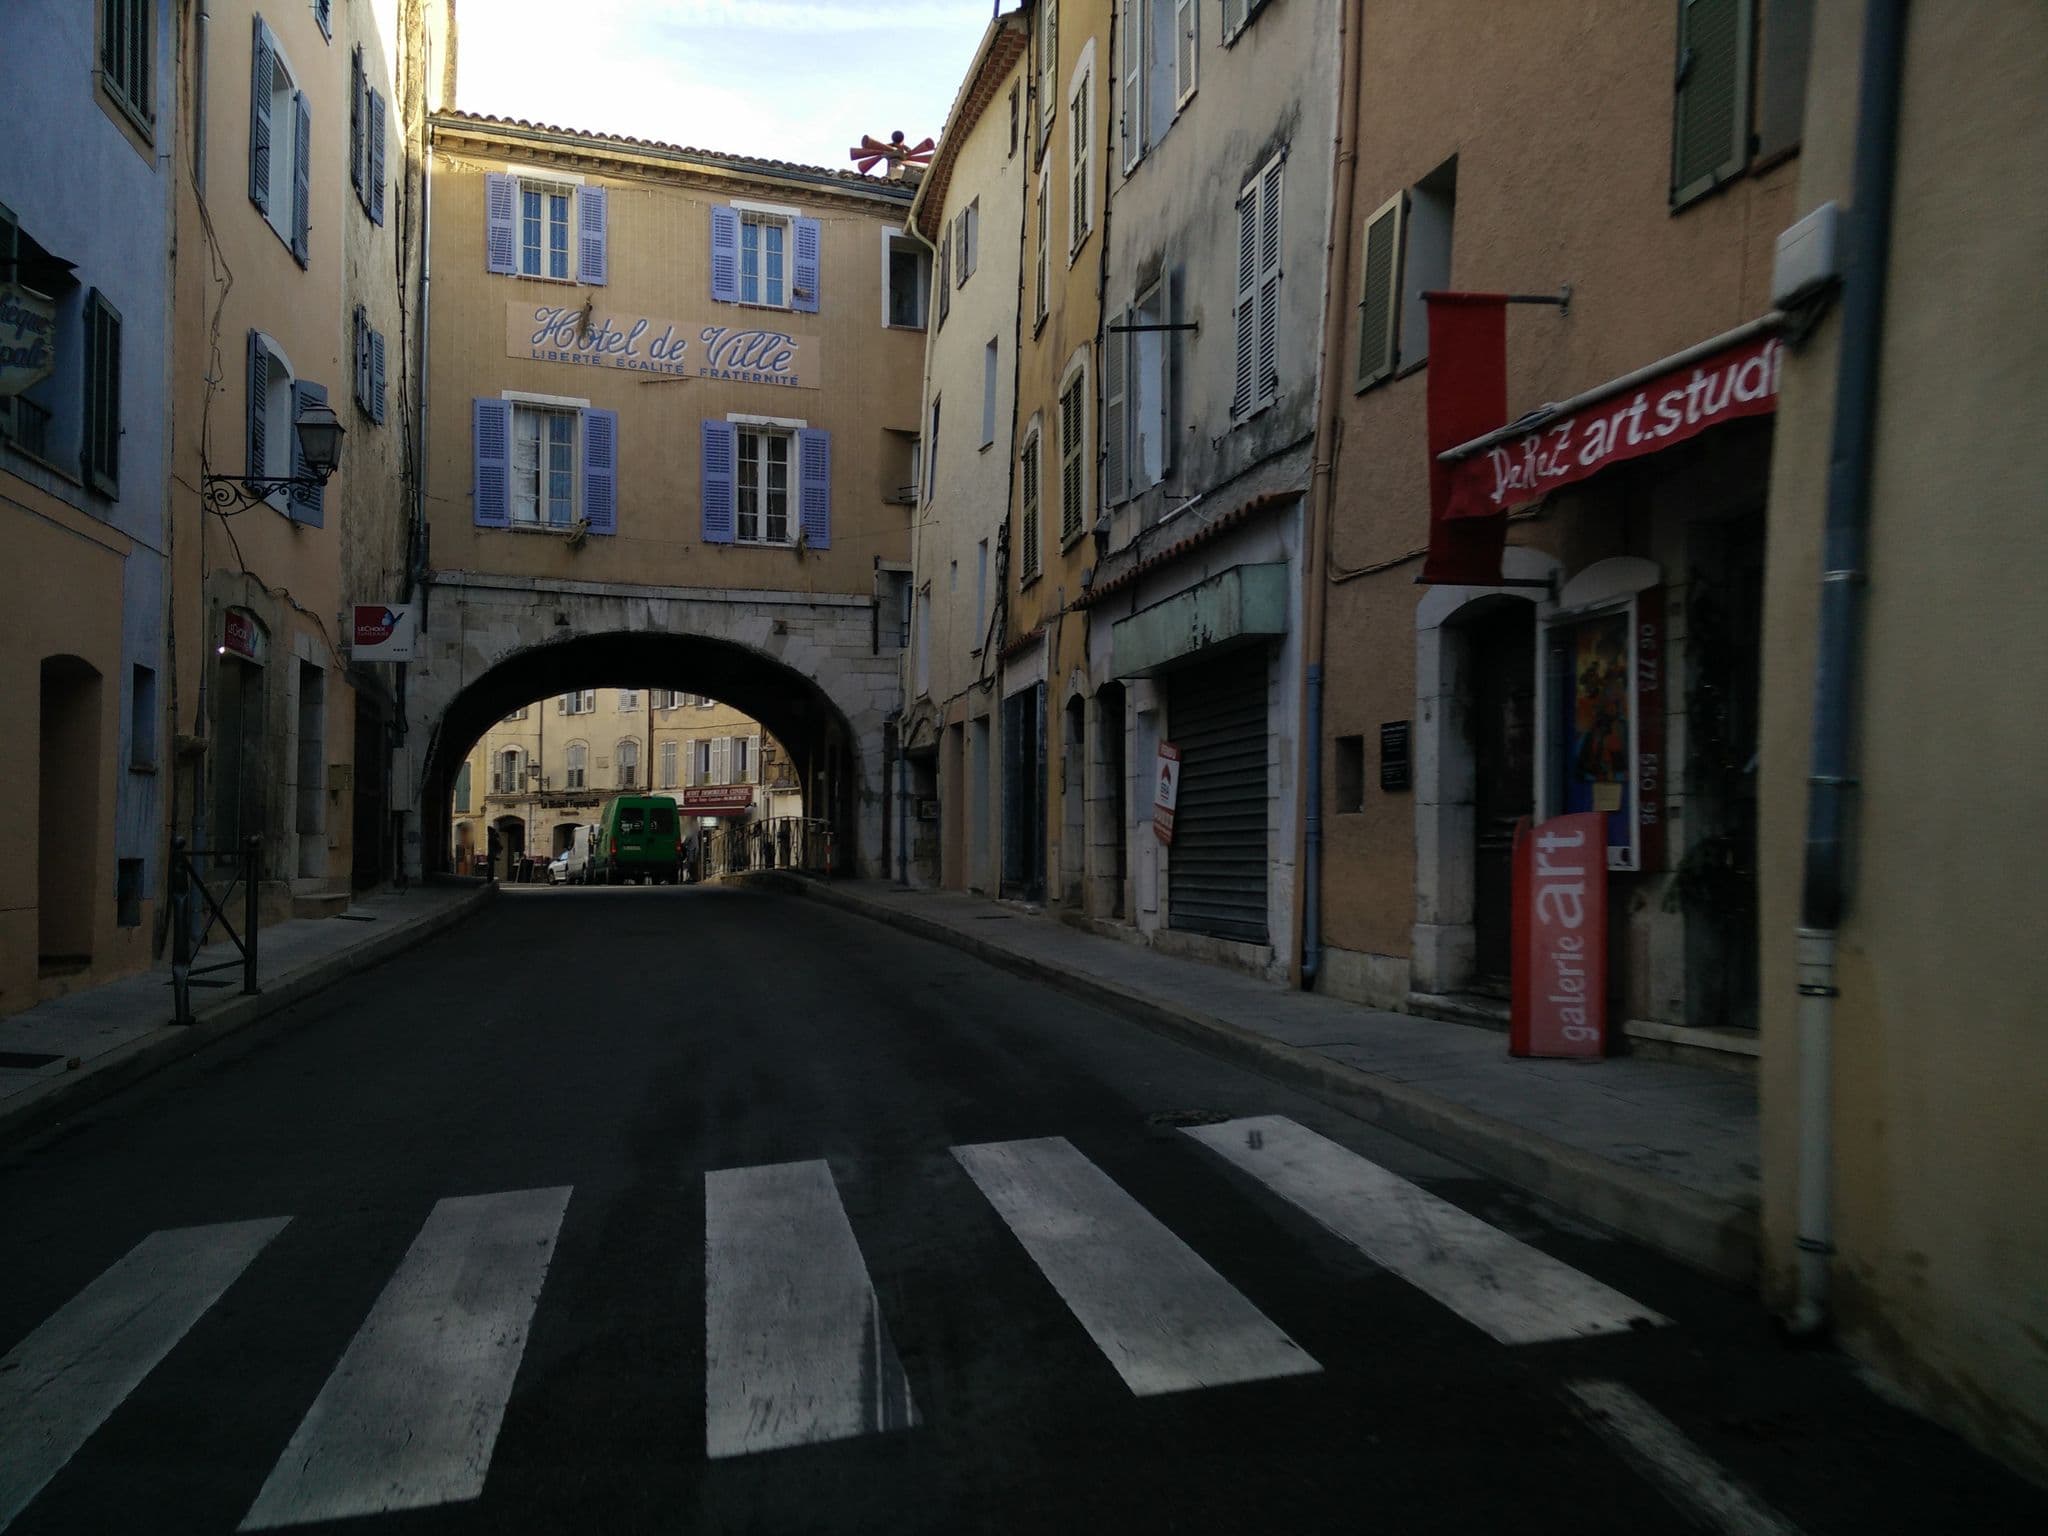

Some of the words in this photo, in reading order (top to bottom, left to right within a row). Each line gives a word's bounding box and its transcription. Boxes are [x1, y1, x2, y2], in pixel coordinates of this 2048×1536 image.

[531, 306, 650, 357] Hôtel
[649, 325, 688, 361] de
[700, 327, 801, 372] Ville
[699, 367, 799, 386] FRATERNITÉ
[1535, 830, 1585, 929] art
[1548, 935, 1600, 1042] galerie
